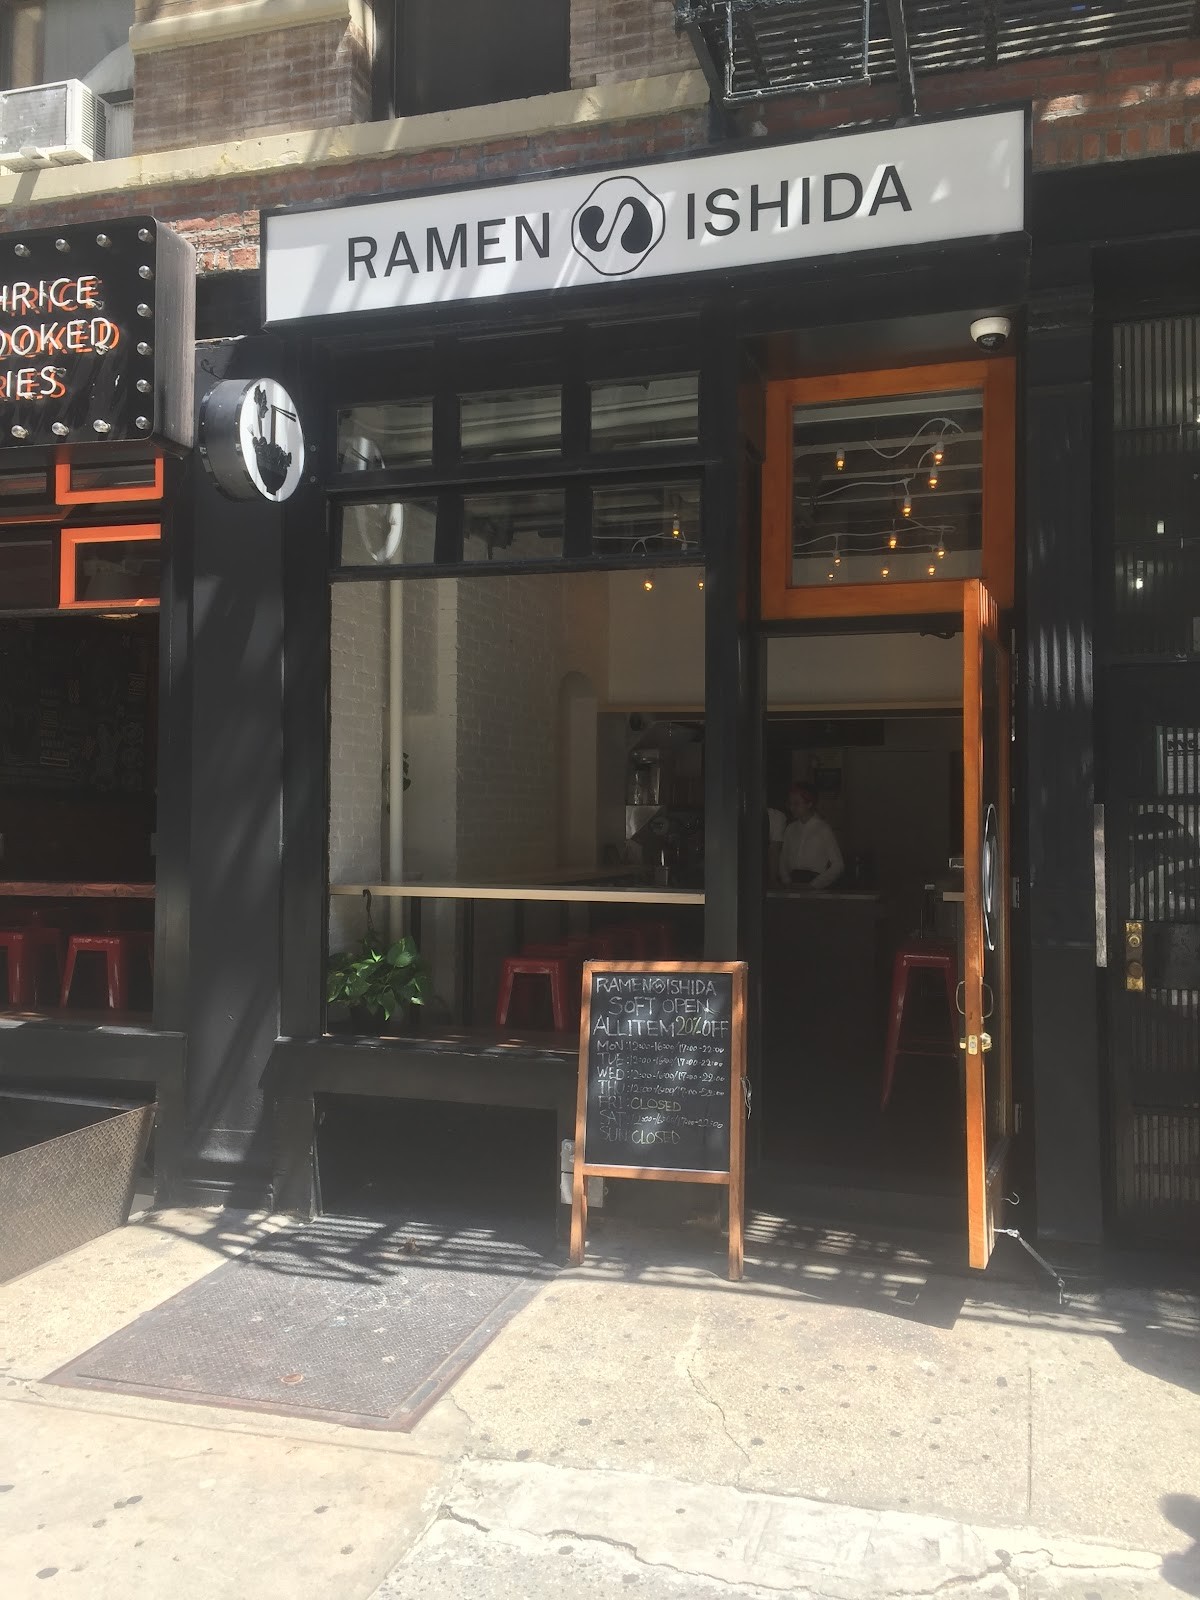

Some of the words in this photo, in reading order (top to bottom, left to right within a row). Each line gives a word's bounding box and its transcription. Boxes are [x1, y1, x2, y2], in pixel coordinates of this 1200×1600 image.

[348, 212, 550, 281] RAMEN
[687, 165, 912, 240] ISHIDA
[597, 978, 652, 993] RAMEN
[667, 978, 717, 996] ISHIDA
[608, 996, 655, 1016] SOFT
[662, 998, 710, 1014] OPEN
[631, 1097, 681, 1111] CLOSED
[632, 1130, 680, 1144] CLOSED
